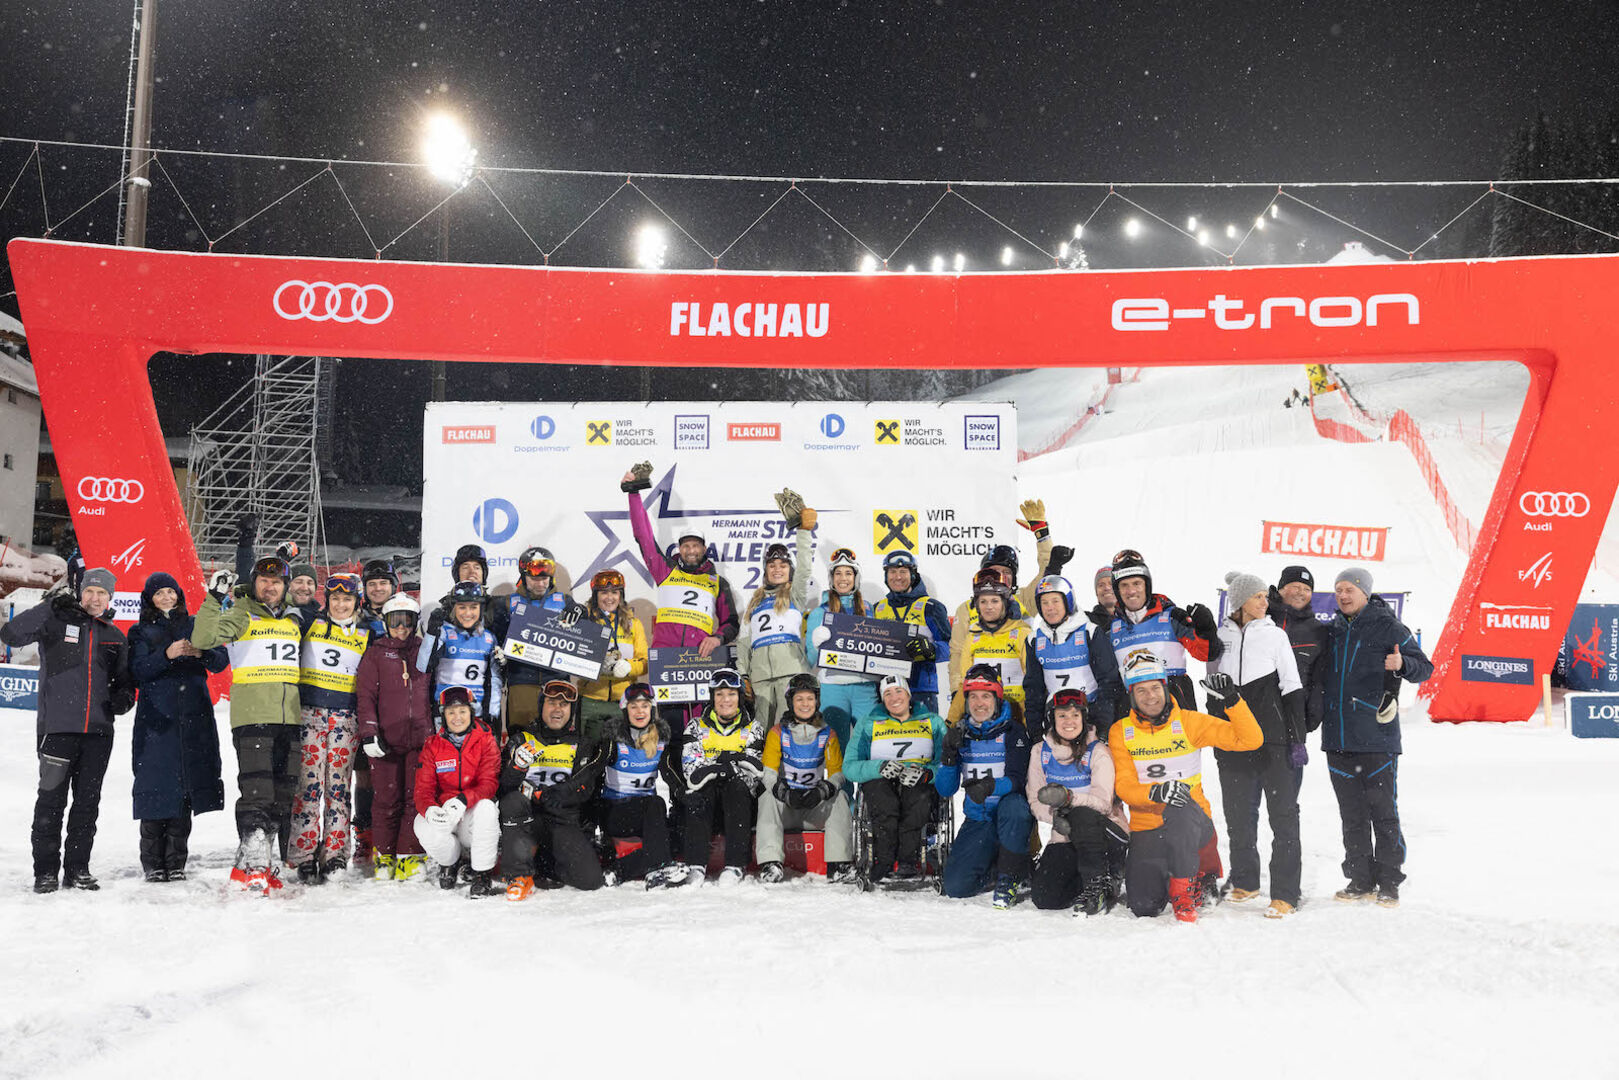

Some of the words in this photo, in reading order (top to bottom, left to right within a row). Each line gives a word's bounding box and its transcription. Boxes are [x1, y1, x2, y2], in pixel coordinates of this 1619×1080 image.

[1111, 294, 1420, 331] e-tron
[670, 302, 830, 337] FLACHAU
[448, 430, 490, 440] FLACHAU
[616, 428, 654, 436] MACHT'S
[732, 427, 776, 438] FLACHAU
[616, 437, 658, 446] MÖGLICH.
[804, 443, 860, 451] Doppelmayr
[904, 437, 947, 446] MÖGLICH.
[514, 445, 570, 453] Doppelmayr
[78, 506, 106, 516] Audi
[926, 510, 955, 522] WIR
[712, 520, 760, 528] HERMANN
[1524, 522, 1552, 531] Audi
[728, 530, 758, 538] MAIER
[926, 526, 994, 538] MACHT'S
[1269, 527, 1379, 558] FLACHAU
[682, 590, 699, 606] 2
[758, 614, 772, 632] 2
[1486, 614, 1550, 630] FLACHAU
[250, 628, 292, 636] Raiffeisen
[532, 631, 576, 652] 10.000
[1608, 618, 1618, 660] Austria
[265, 643, 296, 661] 12
[846, 639, 882, 654] 5.000
[322, 648, 341, 667] 3
[1046, 654, 1087, 663] Doppelmayr
[465, 664, 479, 680] 6
[1468, 660, 1528, 672] LONGINES
[1608, 662, 1618, 682] Ski
[671, 670, 712, 681] 15.000
[1055, 674, 1070, 687] 7
[892, 741, 912, 758] 7
[1146, 764, 1166, 778] 8
[792, 772, 816, 785] 12
[786, 840, 814, 852] Cup
